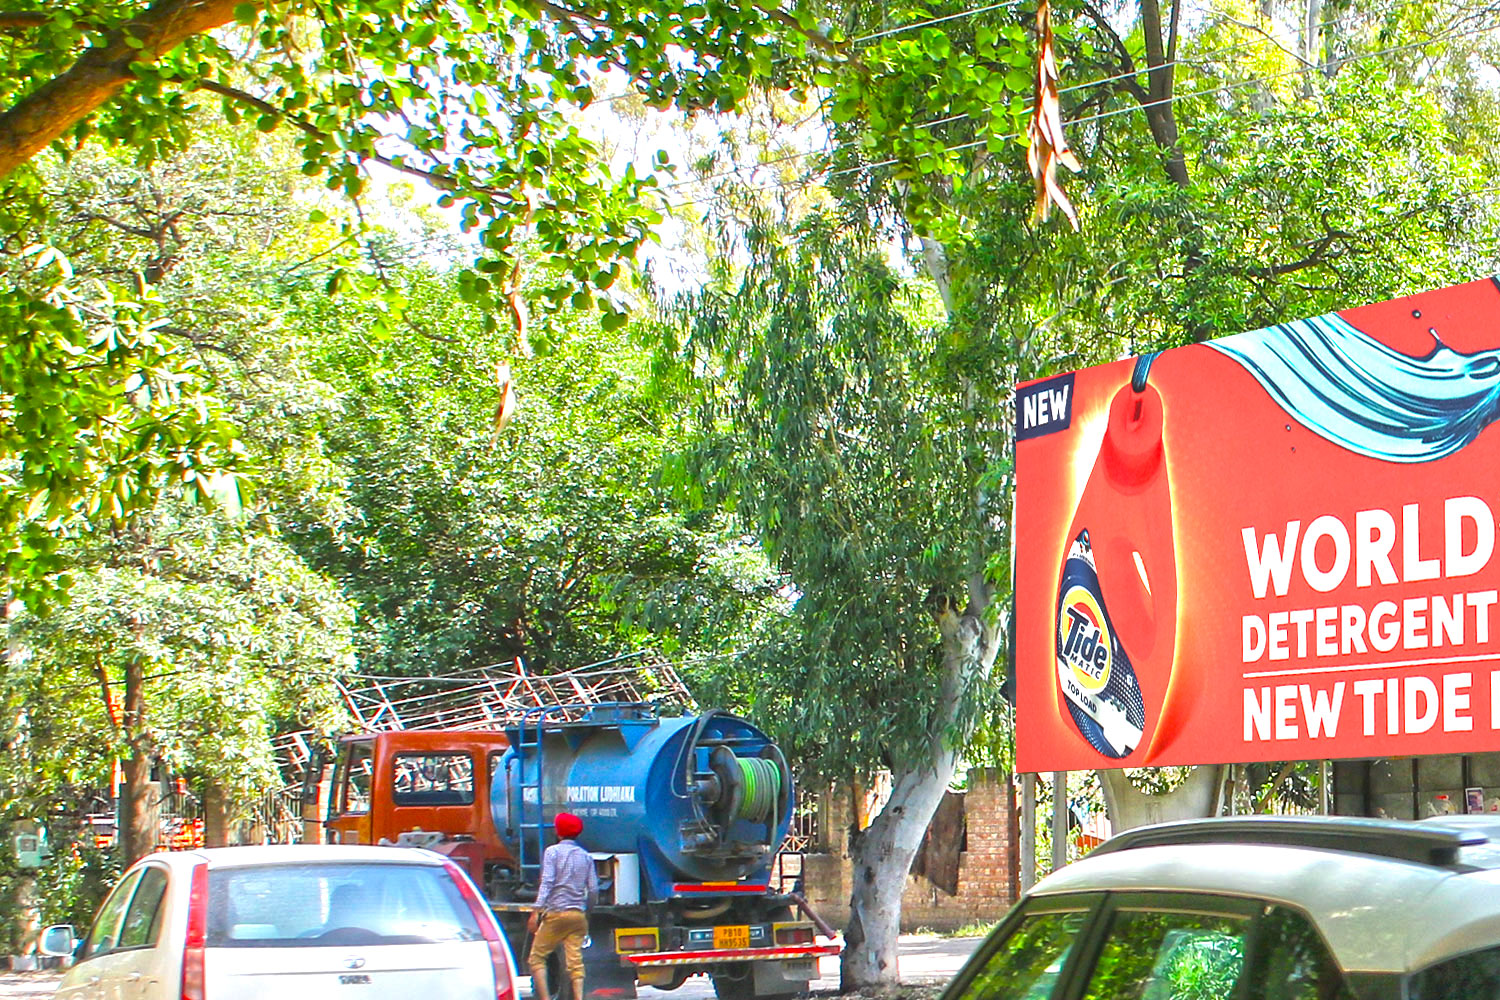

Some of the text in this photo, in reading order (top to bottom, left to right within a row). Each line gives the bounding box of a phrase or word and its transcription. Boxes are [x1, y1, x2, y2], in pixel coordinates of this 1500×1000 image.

[1023, 384, 1069, 430] NEW
[1064, 607, 1107, 670] Tide
[1242, 590, 1498, 663] DETERGENT
[1070, 653, 1102, 680] MATIC
[1067, 679, 1081, 697] TOP
[1080, 692, 1097, 713] LOAD
[1243, 682, 1346, 742] NEW
[1353, 673, 1473, 736] TIDE
[722, 927, 742, 938] PB10
